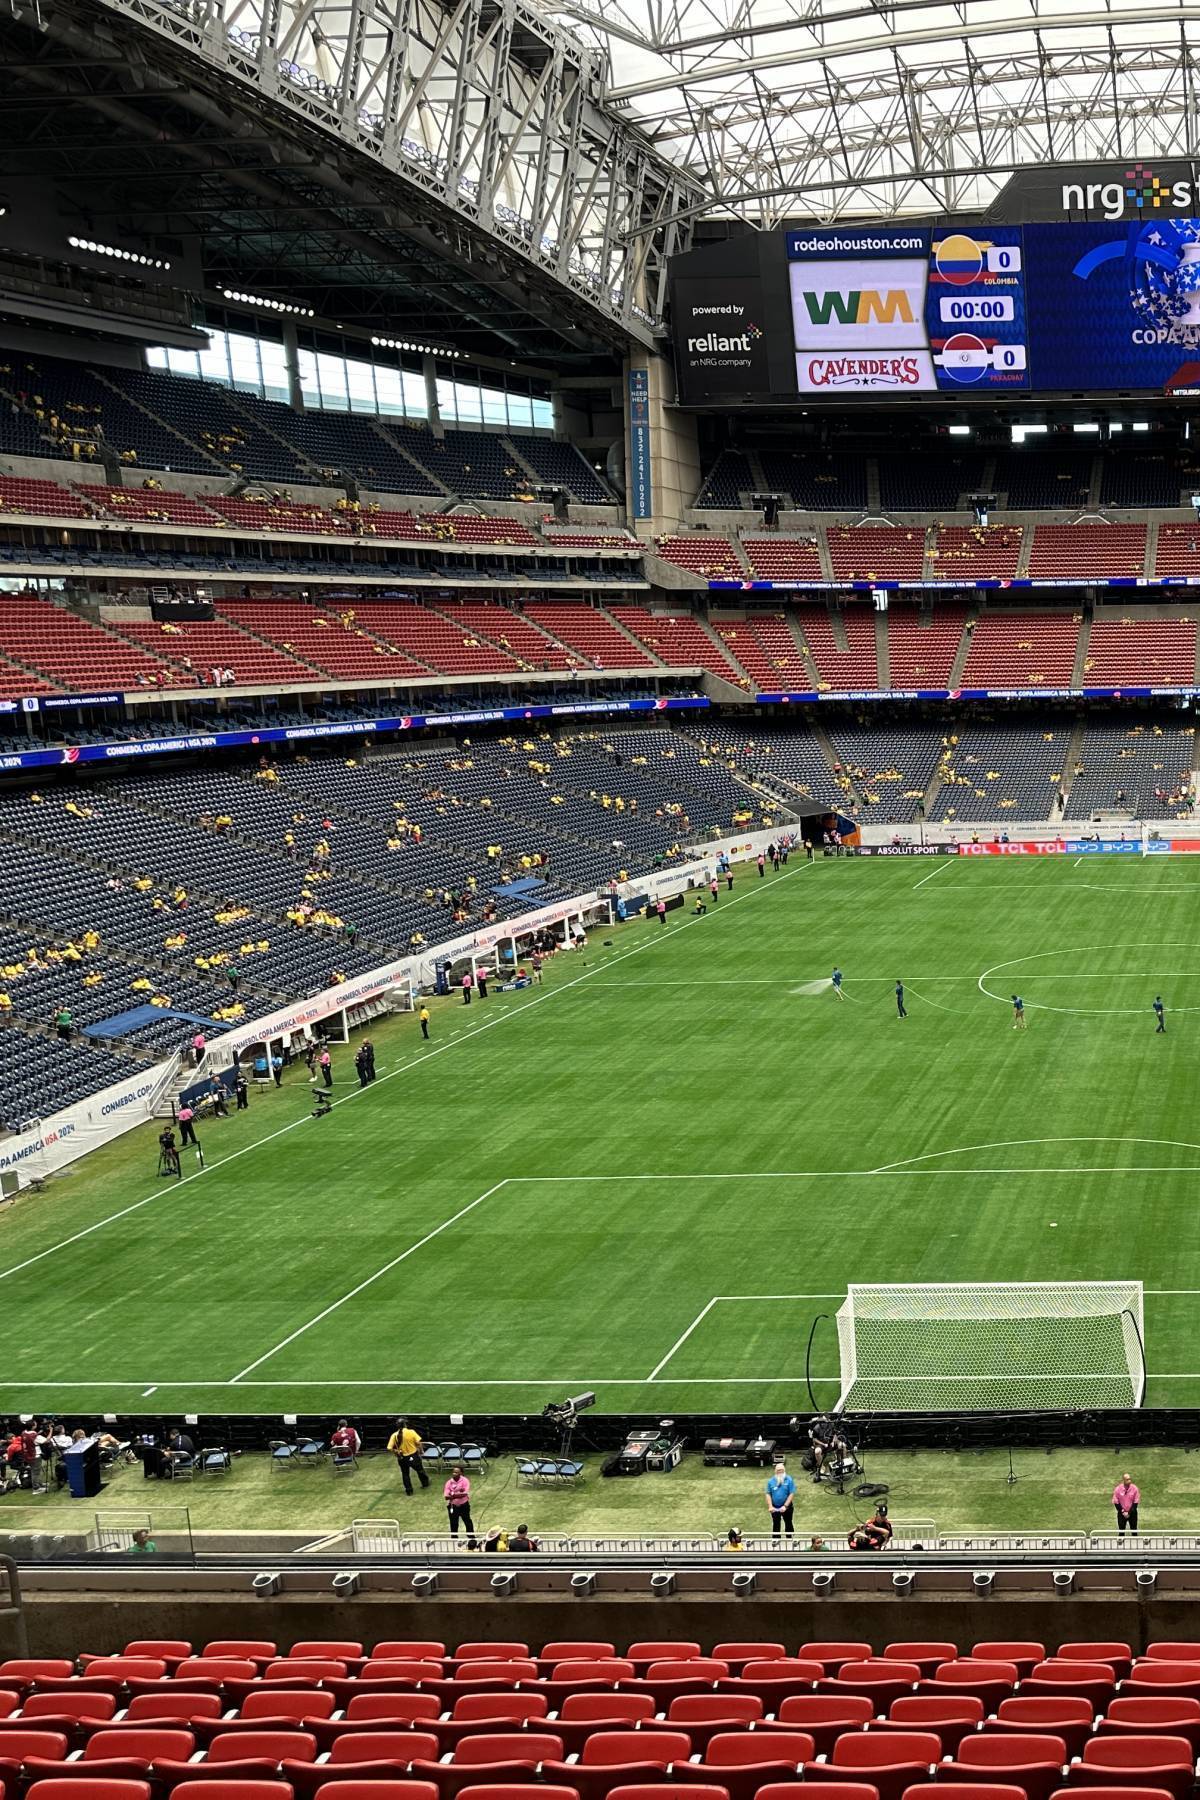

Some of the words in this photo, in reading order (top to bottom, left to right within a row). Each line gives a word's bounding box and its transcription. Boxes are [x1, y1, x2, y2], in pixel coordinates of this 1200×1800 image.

[1063, 183, 1124, 220] nrg
[794, 237, 923, 251] rodeohouston.com
[999, 251, 1010, 268] 0
[692, 305, 731, 316] powered
[733, 305, 744, 315] by
[803, 290, 914, 324] WM
[950, 301, 1004, 318] 00:00
[687, 333, 751, 352] reliant
[1132, 329, 1177, 345] COPA
[700, 358, 717, 366] NRG
[718, 358, 751, 368] company
[1003, 350, 1015, 366] 0
[808, 356, 920, 385] CAVENDER'S
[877, 846, 912, 855] ABSOLUT
[913, 846, 939, 855] SPORT
[961, 844, 991, 854] TCL
[1000, 844, 1028, 854] TCL
[1034, 844, 1067, 854] TCL
[101, 1094, 137, 1116] CONMEBOL
[137, 1084, 152, 1099] COP
[0, 1157, 11, 1169] PA
[11, 1140, 45, 1164] AMERICA
